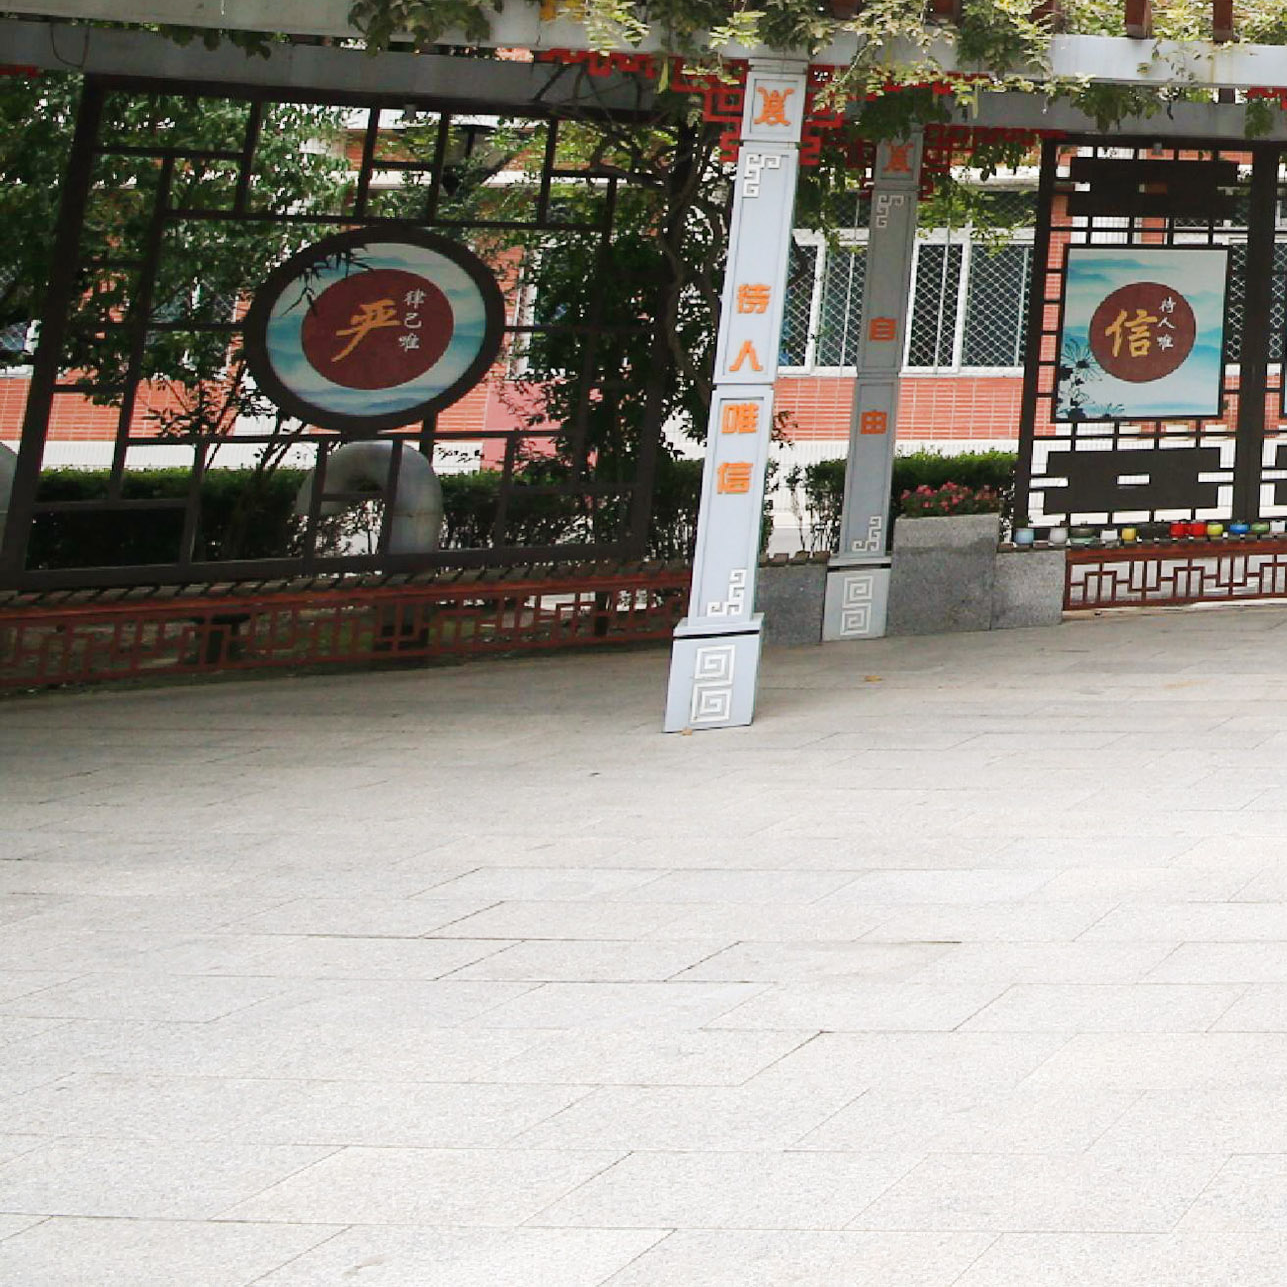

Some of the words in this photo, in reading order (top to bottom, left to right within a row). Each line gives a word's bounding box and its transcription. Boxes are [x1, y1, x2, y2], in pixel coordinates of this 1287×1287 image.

[331, 298, 402, 363] 严
[399, 288, 427, 352] 律己唯
[1104, 308, 1158, 358] 信
[1156, 296, 1177, 352] 待人唯
[716, 283, 772, 495] 待人唯信
[859, 317, 898, 435] 自由
